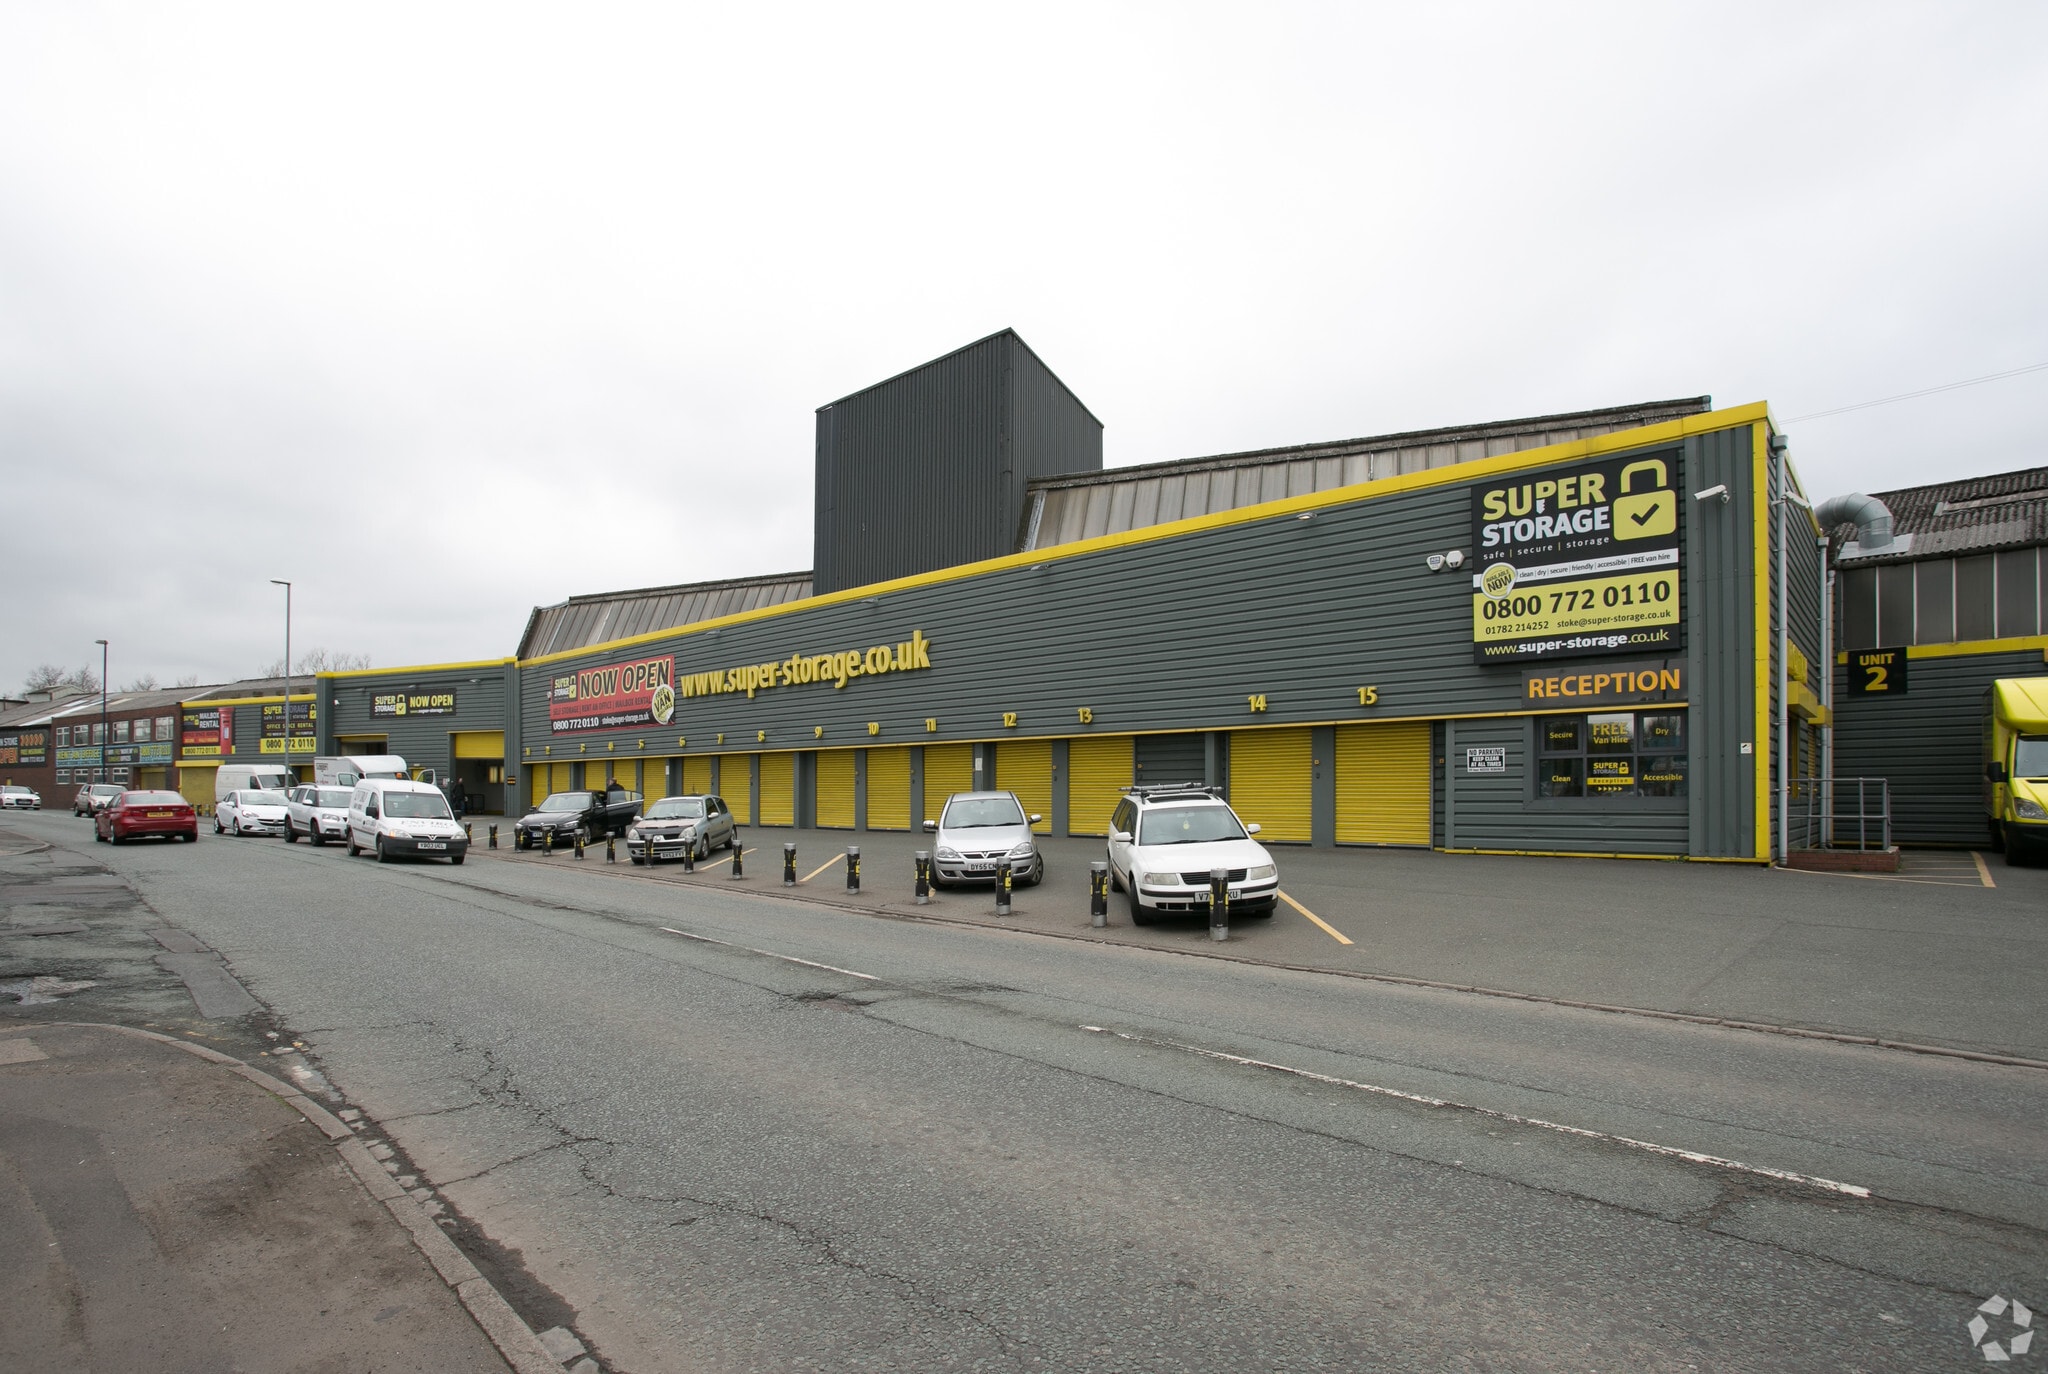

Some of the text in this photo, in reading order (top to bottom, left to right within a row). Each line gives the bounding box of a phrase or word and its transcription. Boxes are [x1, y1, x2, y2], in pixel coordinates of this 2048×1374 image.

[1482, 473, 1606, 520] SUPER
[1482, 506, 1610, 547] STORAGE
[1483, 537, 1610, 560] safe secure storage
[1571, 563, 1593, 572] friendly
[1597, 559, 1627, 568] accessible
[1487, 574, 1511, 592] NOW
[1483, 580, 1670, 620] 0800 772 0110
[1557, 609, 1671, 628] stoke@super-storage.co.uk
[1485, 620, 1549, 635] 01782 214252
[1485, 628, 1669, 656] www.super-storage.co.uk
[680, 629, 931, 699] www.super-storage.co.uk
[1859, 653, 1895, 666] UNIT
[580, 659, 671, 699] NOW OPEN
[1528, 668, 1680, 699] RECEPTION
[1865, 667, 1888, 691] 2
[375, 695, 396, 705] SUPER
[410, 694, 453, 708] NOW OPEN
[654, 691, 671, 712] VAN
[1357, 686, 1378, 705] 15
[264, 704, 308, 715] SUPER SORAGE
[375, 704, 396, 712] STORAGE
[1248, 694, 1267, 712] 14
[1003, 713, 1017, 728] 12
[1078, 707, 1093, 723] 13
[199, 720, 220, 728] RENTAL
[553, 717, 599, 730] 0800 772 0110
[867, 722, 880, 736] 10
[925, 718, 937, 732] 11
[1592, 721, 1628, 736] FREE
[757, 731, 766, 743] 8
[814, 726, 823, 738] 9
[1549, 731, 1573, 739] Secure
[1655, 727, 1669, 736] Dry
[266, 739, 282, 749] 0800
[298, 738, 315, 748] 0110
[638, 739, 645, 750] 5
[679, 736, 686, 748] 6
[717, 733, 724, 745] 7
